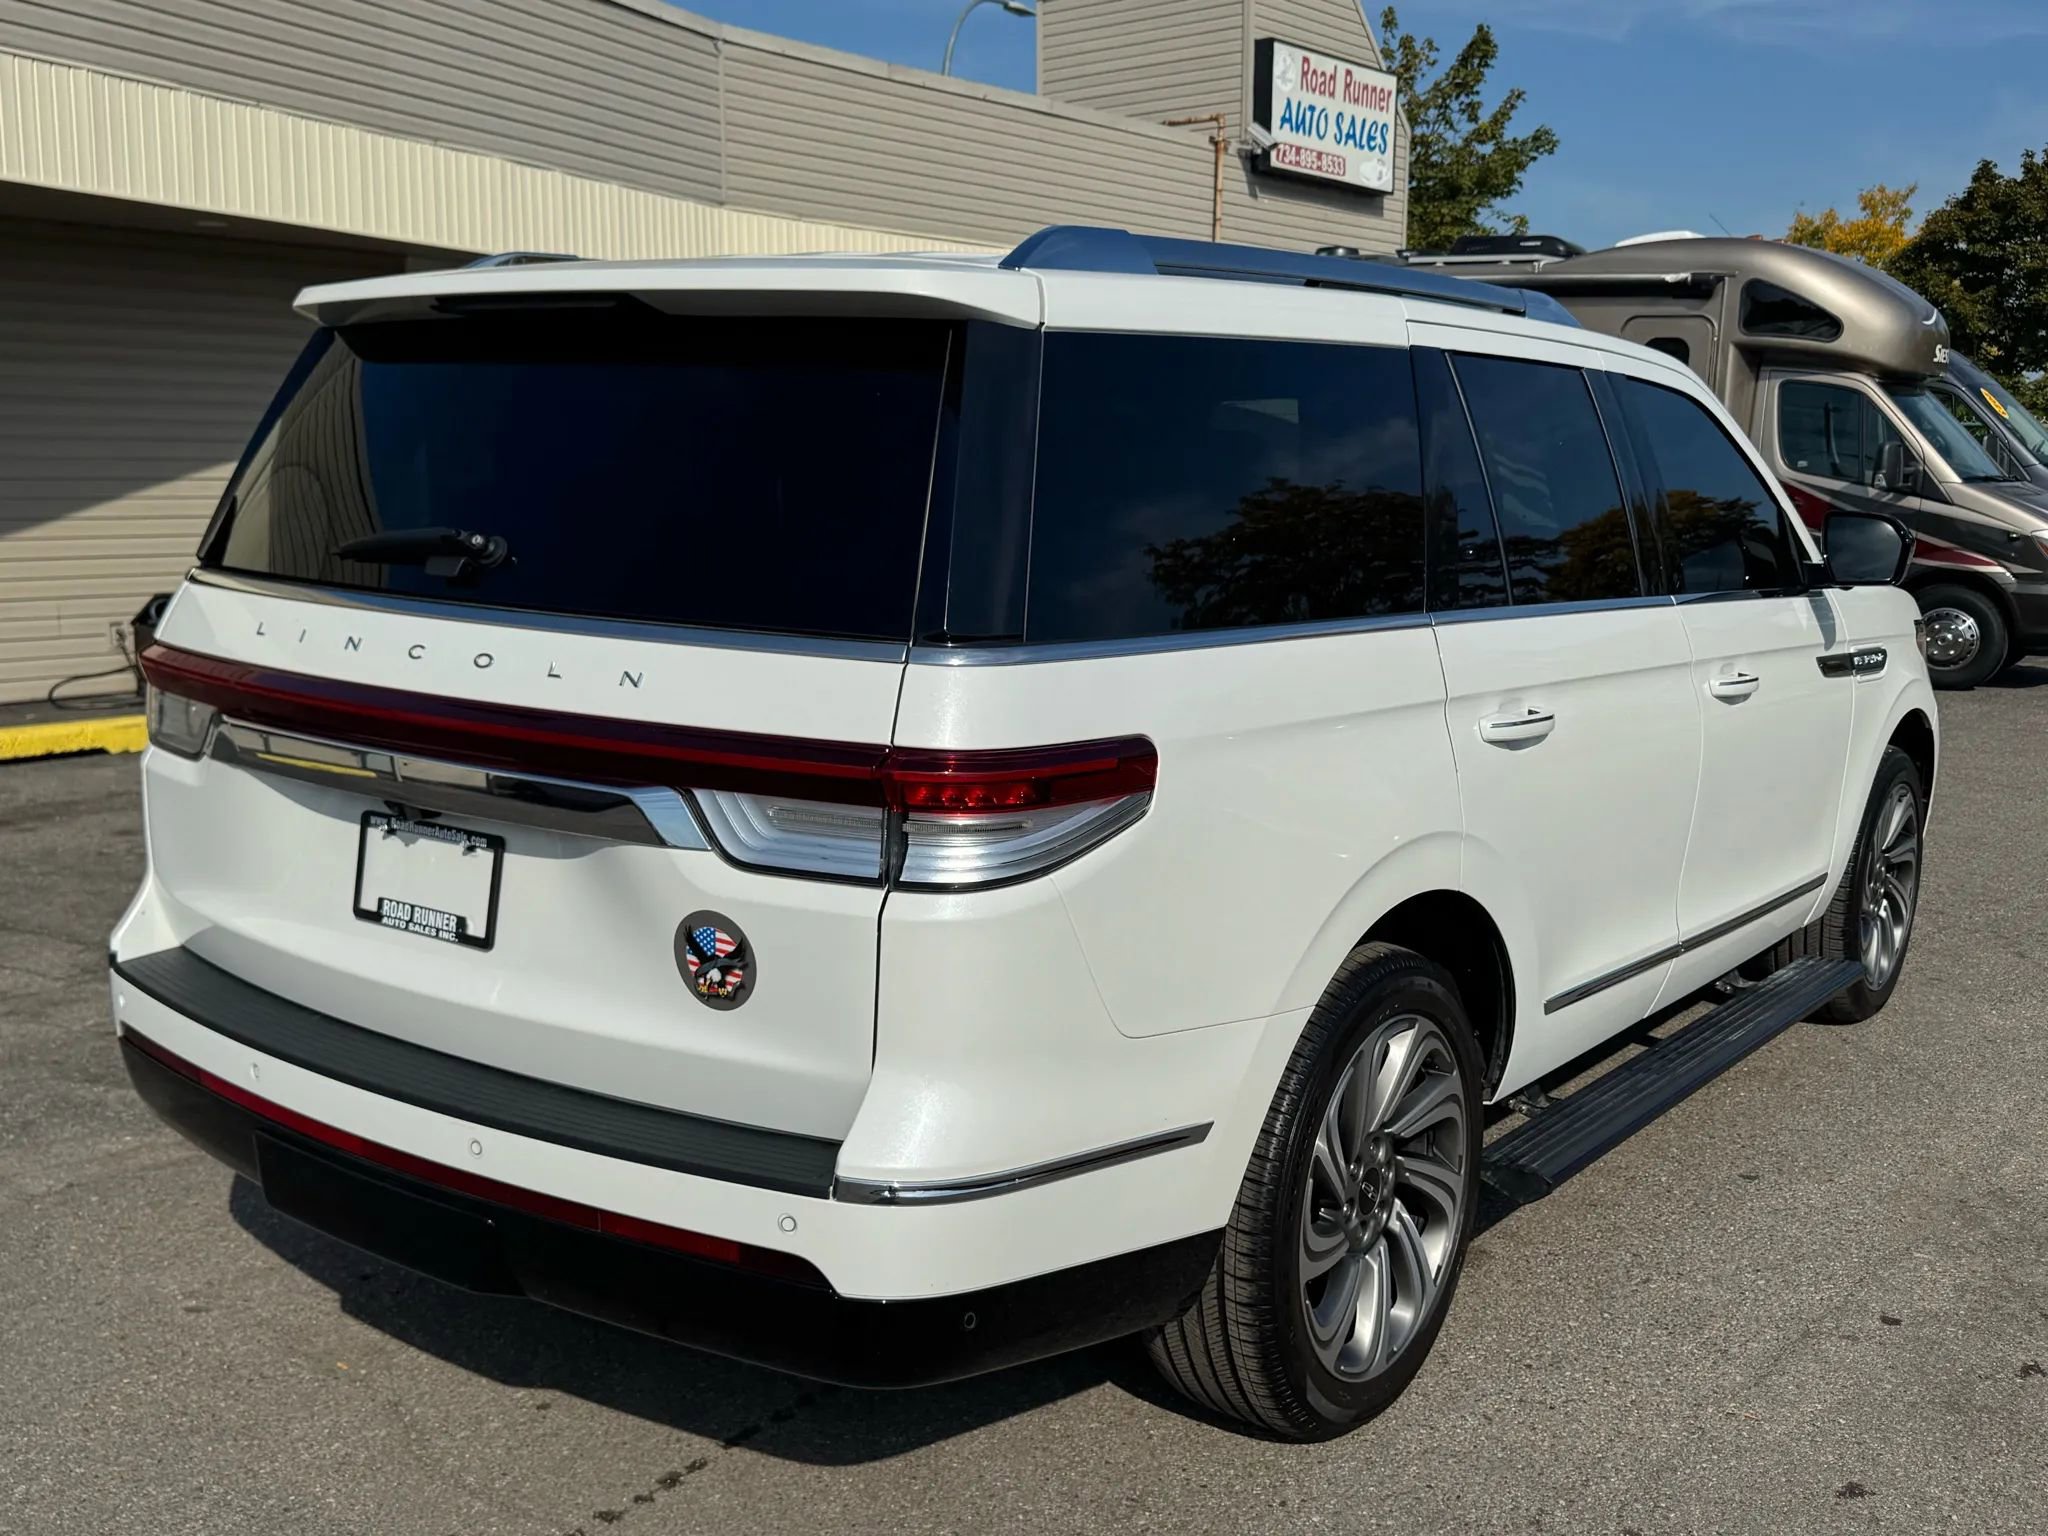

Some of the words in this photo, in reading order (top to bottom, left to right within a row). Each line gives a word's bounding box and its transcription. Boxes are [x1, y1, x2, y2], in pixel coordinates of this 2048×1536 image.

[1300, 55, 1338, 100] Road
[1343, 67, 1392, 114] Runner
[1279, 97, 1329, 141] AUTO
[1334, 111, 1389, 155] SALES
[256, 621, 643, 689] LINCOLN
[381, 916, 406, 929] AUTO
[408, 921, 437, 937] SALES
[438, 930, 459, 943] INC.
[382, 899, 412, 922] ROAD
[413, 906, 458, 933] RUNNER
